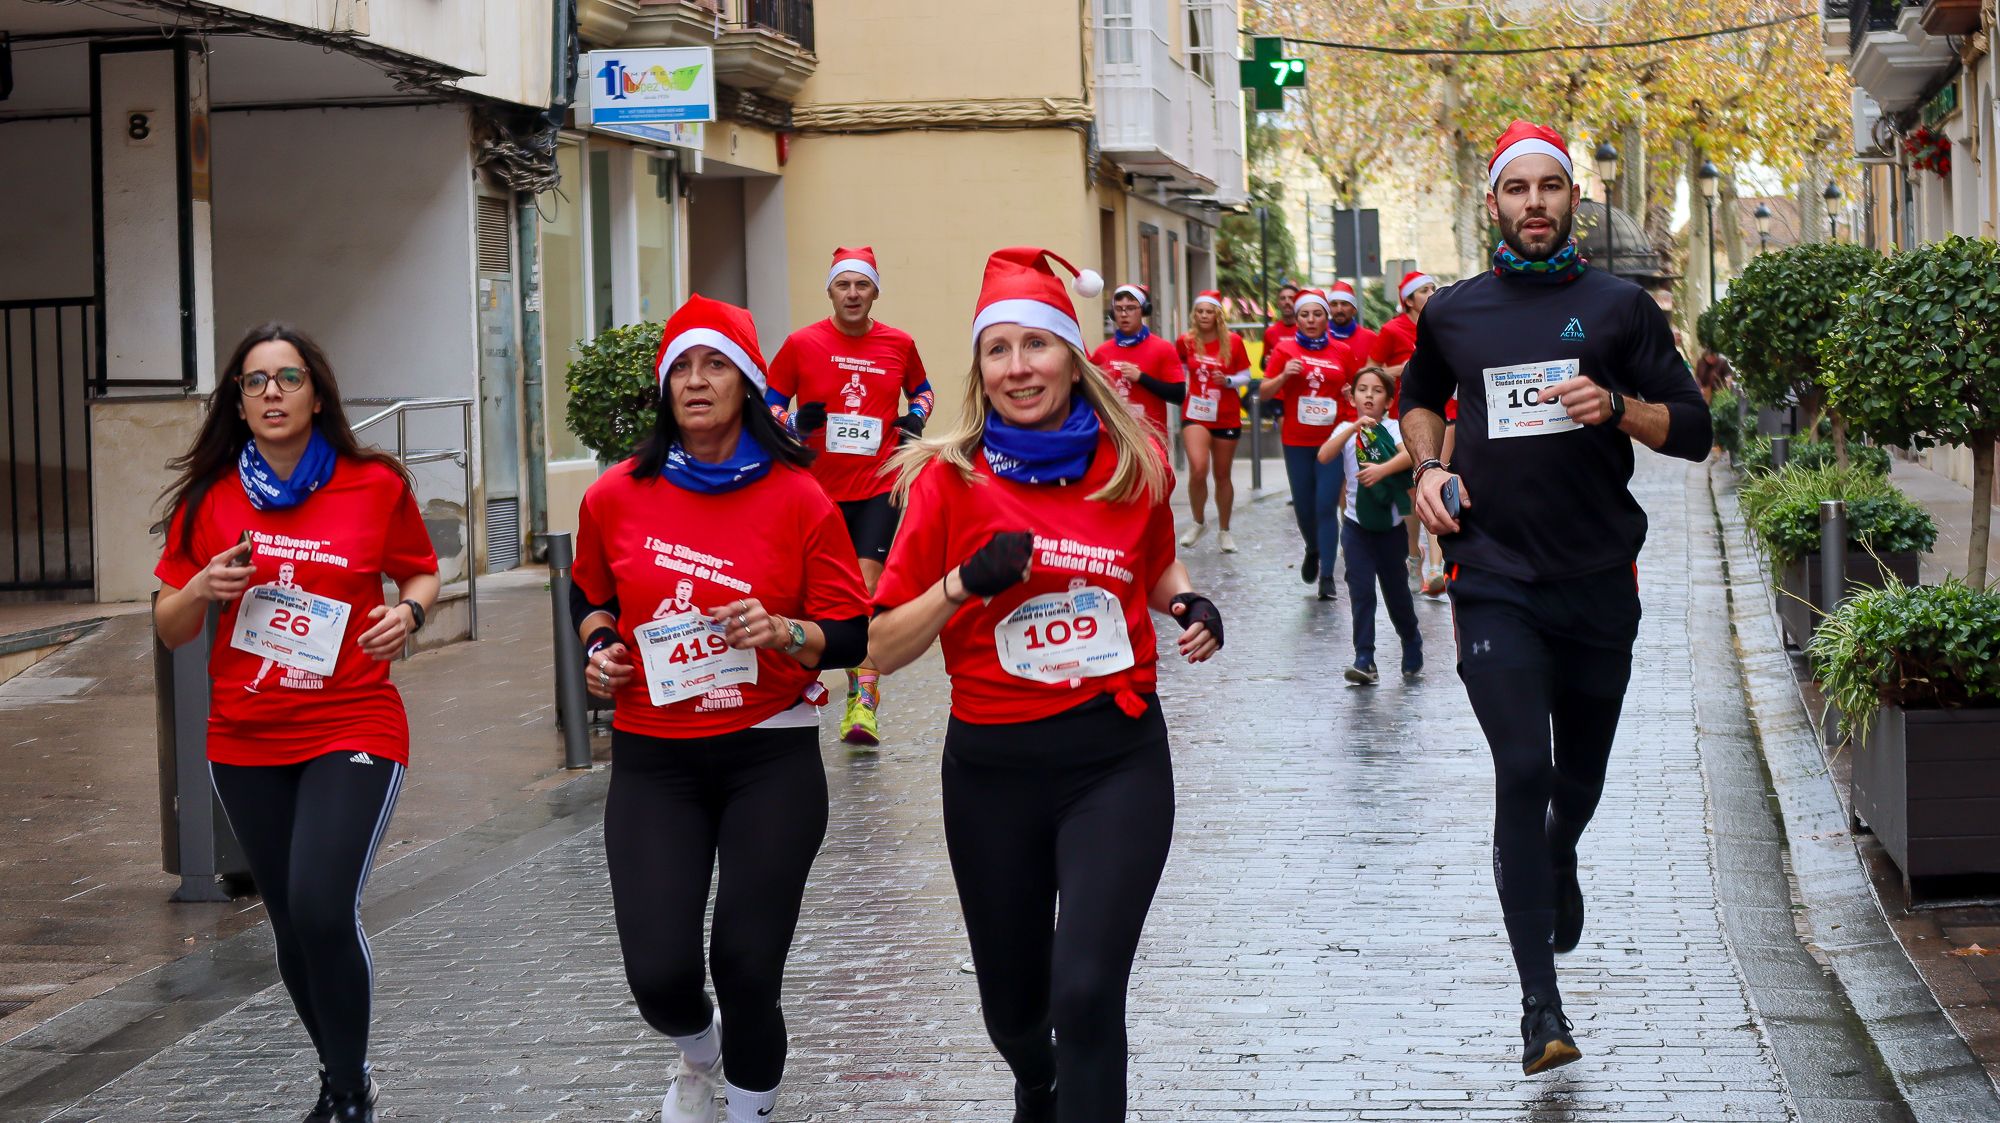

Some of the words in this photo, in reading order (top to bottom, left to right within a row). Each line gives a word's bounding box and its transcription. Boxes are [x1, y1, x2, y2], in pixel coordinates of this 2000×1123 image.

[128, 113, 150, 140] 8
[1305, 405, 1328, 415] 209
[837, 426, 870, 440] 284
[253, 530, 274, 545] San
[273, 534, 321, 550] Silvestre
[257, 544, 295, 560] Ciudad
[295, 550, 310, 561] de
[310, 550, 349, 568] Lucena
[644, 536, 653, 549] I
[651, 538, 674, 555] San
[672, 544, 724, 570] Silvestre
[1033, 535, 1059, 552] San
[1059, 538, 1116, 562] Silvestre
[1041, 551, 1088, 572] Ciudad
[1087, 558, 1105, 574] de
[654, 553, 696, 576] Ciudad
[694, 565, 711, 580] de
[710, 569, 753, 595] Lucena
[285, 600, 306, 612] Lucena
[1022, 601, 1054, 613] Silvestre
[1033, 611, 1044, 619] de
[1044, 608, 1071, 617] Lucena
[268, 608, 312, 637] 26
[648, 630, 660, 638] San
[660, 622, 691, 635] Silvestre
[649, 635, 673, 645] Ciudad
[681, 625, 706, 637] Lucena
[1023, 616, 1098, 651] 109
[297, 651, 325, 663] enerplus
[668, 633, 729, 665] 419
[1086, 651, 1119, 662] enerplus
[720, 666, 749, 675] enerplus
[279, 676, 324, 690] MARJALIZO
[707, 688, 743, 700] CARLOS
[701, 695, 744, 710] HURTADO
